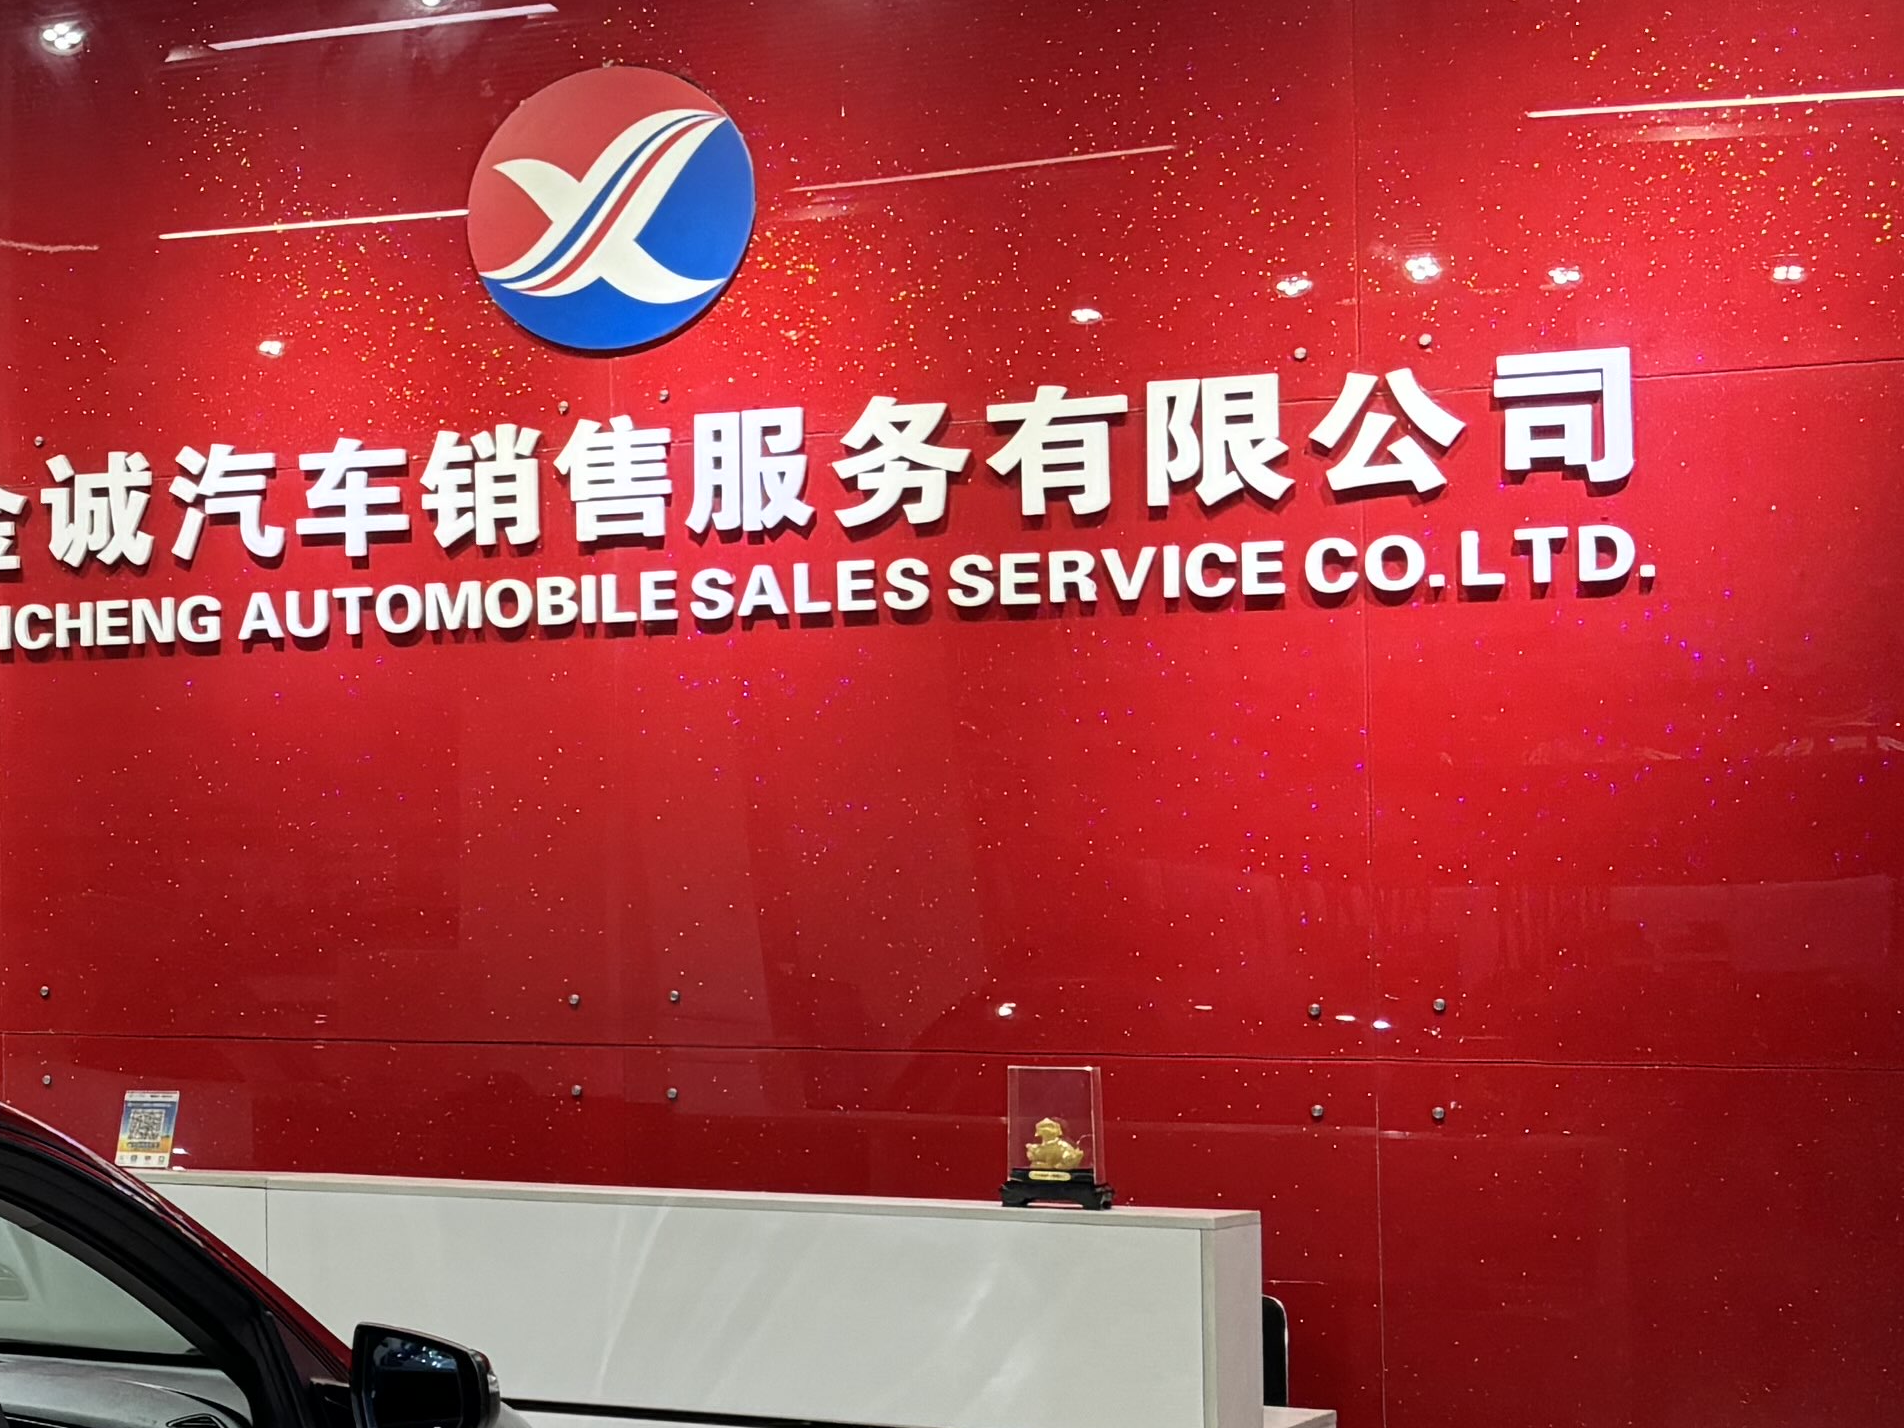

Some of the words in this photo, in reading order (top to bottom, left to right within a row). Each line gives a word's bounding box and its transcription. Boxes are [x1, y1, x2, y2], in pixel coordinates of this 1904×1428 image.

[238, 575, 678, 641] AUTOMOBILE
[689, 558, 930, 620] SALES
[948, 530, 1286, 606] SERVICE
